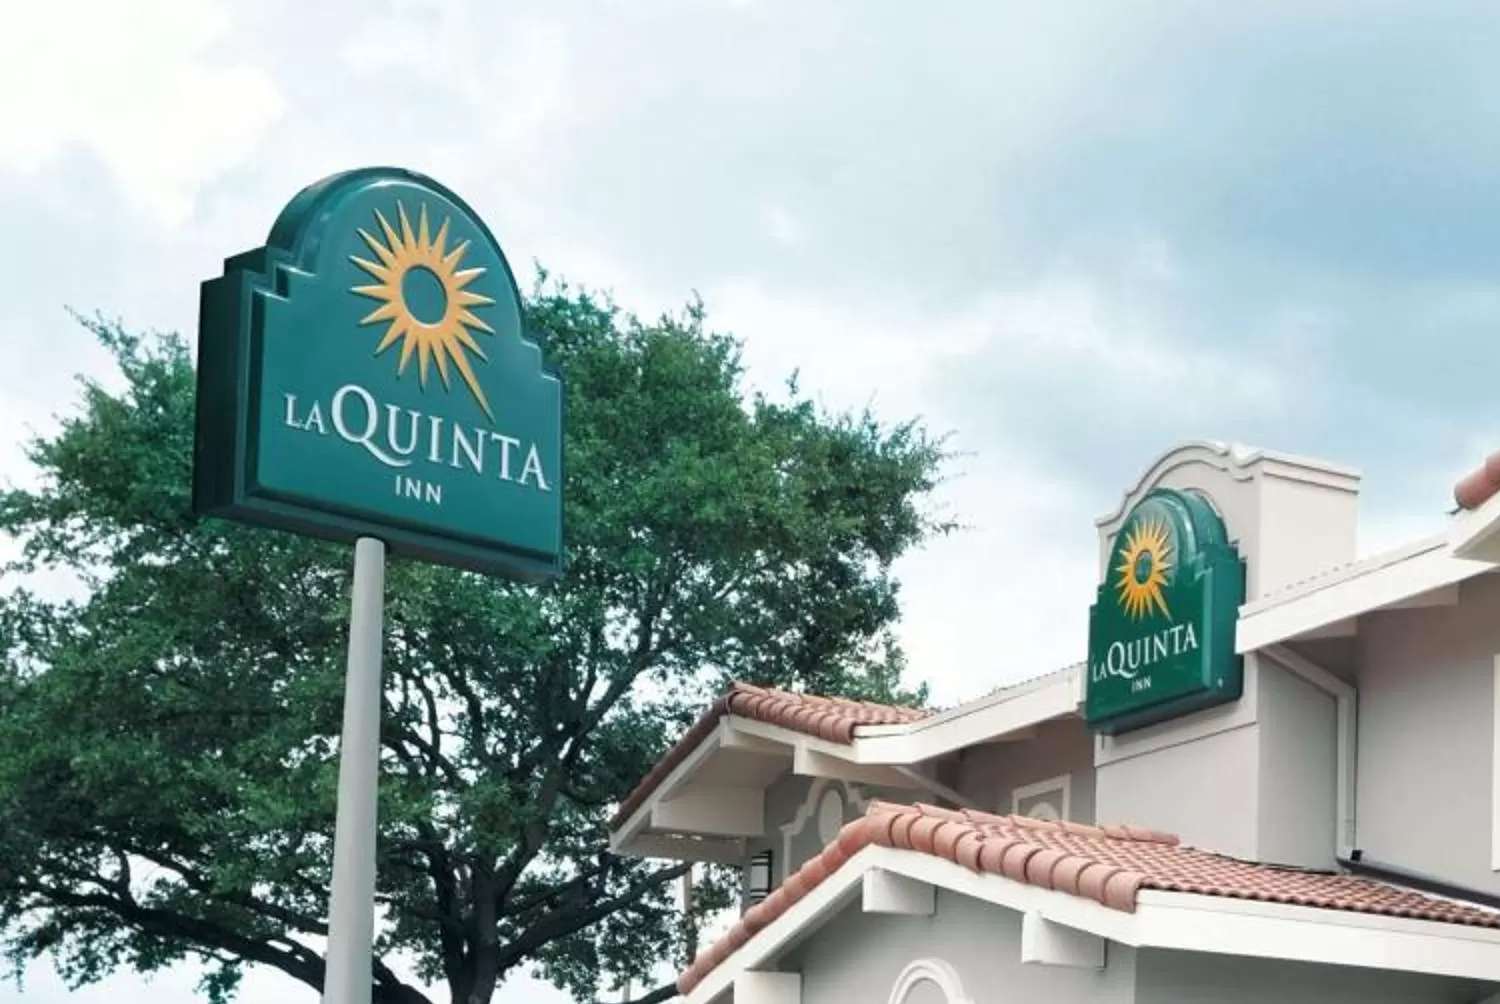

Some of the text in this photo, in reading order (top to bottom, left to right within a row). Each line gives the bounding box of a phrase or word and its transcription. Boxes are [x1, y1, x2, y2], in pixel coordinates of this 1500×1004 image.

[284, 384, 552, 491] LA QUINTA
[394, 475, 442, 505] INN
[1092, 622, 1198, 682] LA QUINTA
[1131, 676, 1151, 693] INN
